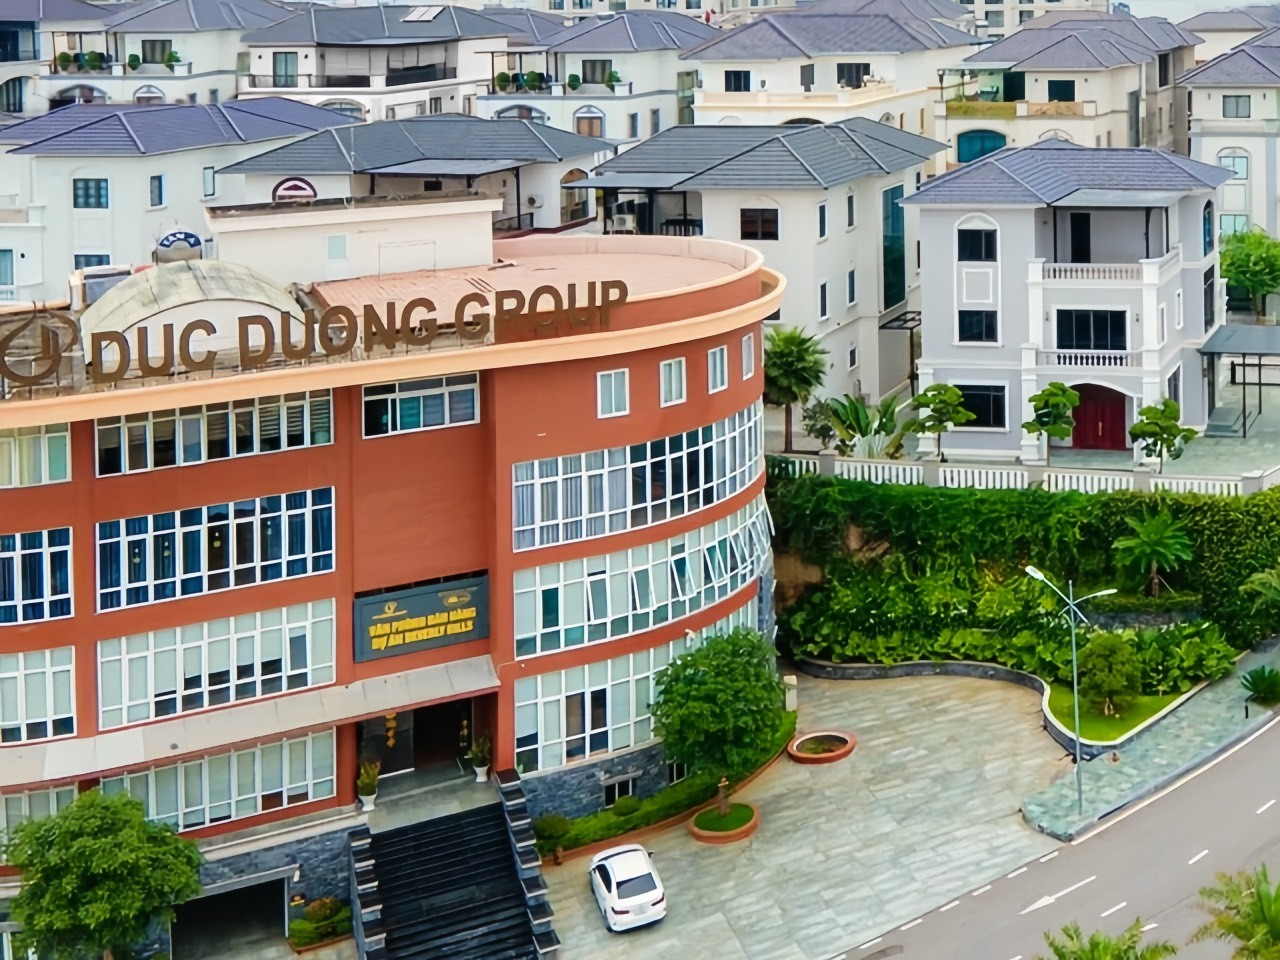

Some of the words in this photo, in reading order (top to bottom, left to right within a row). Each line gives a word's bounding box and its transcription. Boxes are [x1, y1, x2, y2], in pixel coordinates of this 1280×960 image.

[91, 319, 218, 384] DUC
[238, 297, 437, 371] DUONG
[455, 279, 629, 341] GROUP
